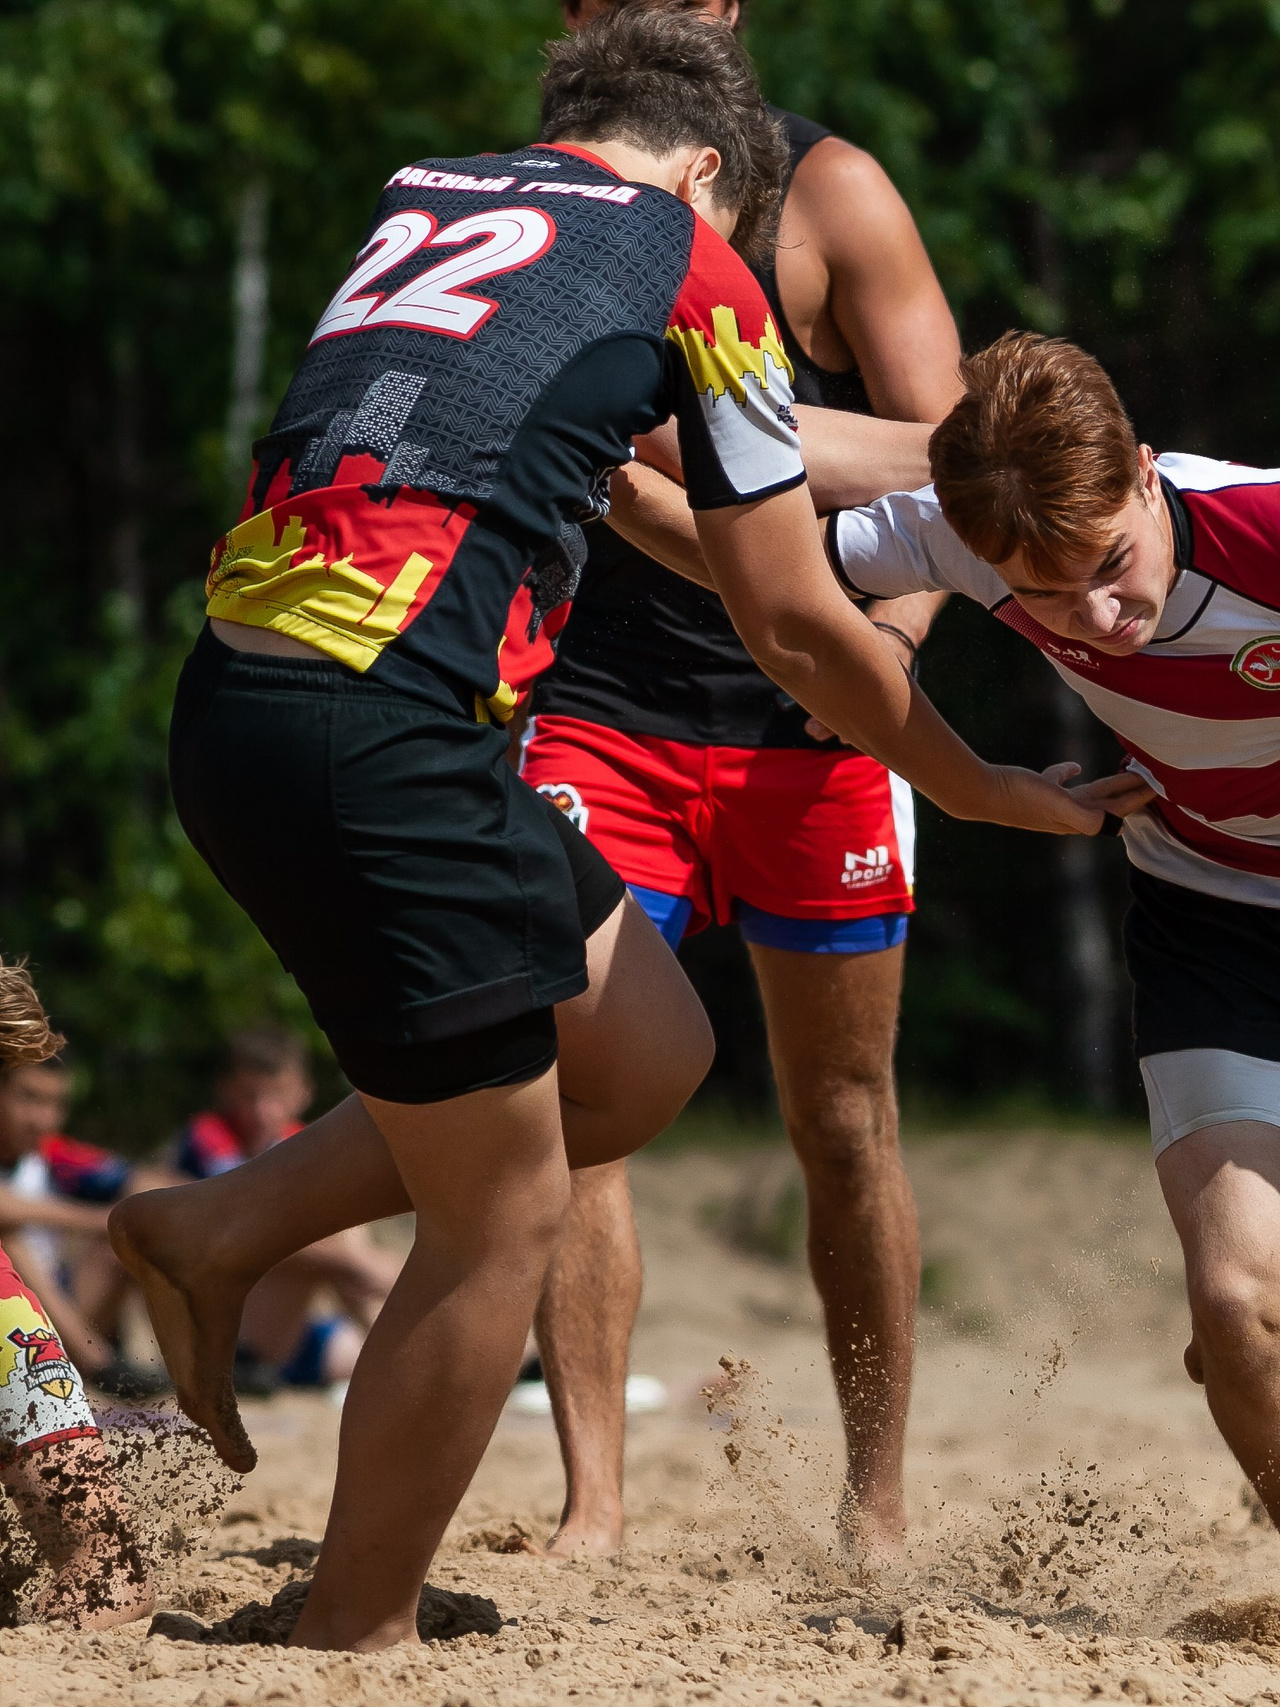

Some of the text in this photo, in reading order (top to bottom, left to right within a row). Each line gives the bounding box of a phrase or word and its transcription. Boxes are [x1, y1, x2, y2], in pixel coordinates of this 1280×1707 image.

[517, 181, 640, 205] ГОРОД
[308, 209, 556, 346] 22
[841, 864, 893, 884] SPORT
